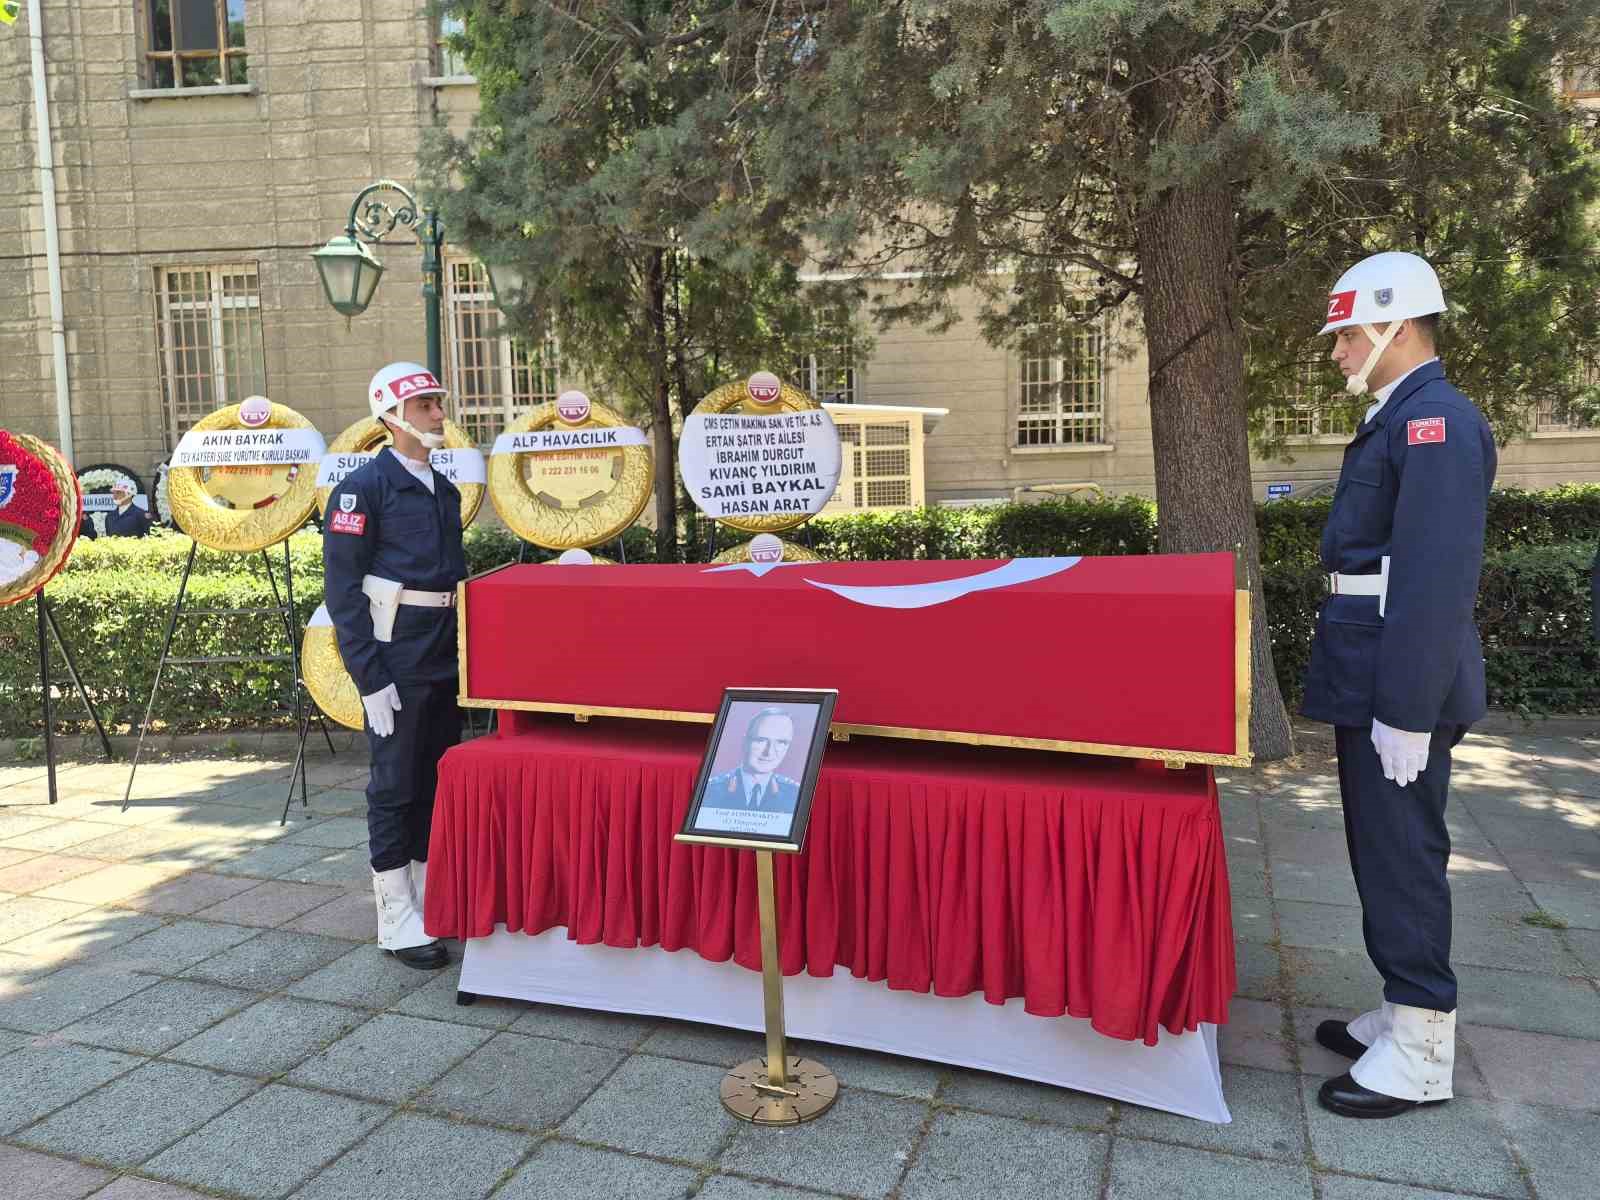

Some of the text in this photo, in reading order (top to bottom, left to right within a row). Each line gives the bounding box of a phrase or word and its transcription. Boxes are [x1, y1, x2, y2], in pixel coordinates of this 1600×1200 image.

[751, 387, 777, 396] TEV
[241, 411, 268, 420] TEV
[560, 407, 587, 415] TEV
[785, 416, 794, 428] VE
[202, 433, 284, 446] AKIN BAYRAK
[512, 431, 617, 449] ALP HAVACILIK
[706, 435, 735, 448] ERTAN
[764, 433, 776, 445] VE
[762, 447, 804, 461] DURGUT
[710, 462, 816, 480] KIVANÇ YILDIRIM
[701, 477, 825, 499] SAMİ BAYKAL
[721, 498, 811, 514] HASAN ARAT
[752, 551, 779, 560] TEV
